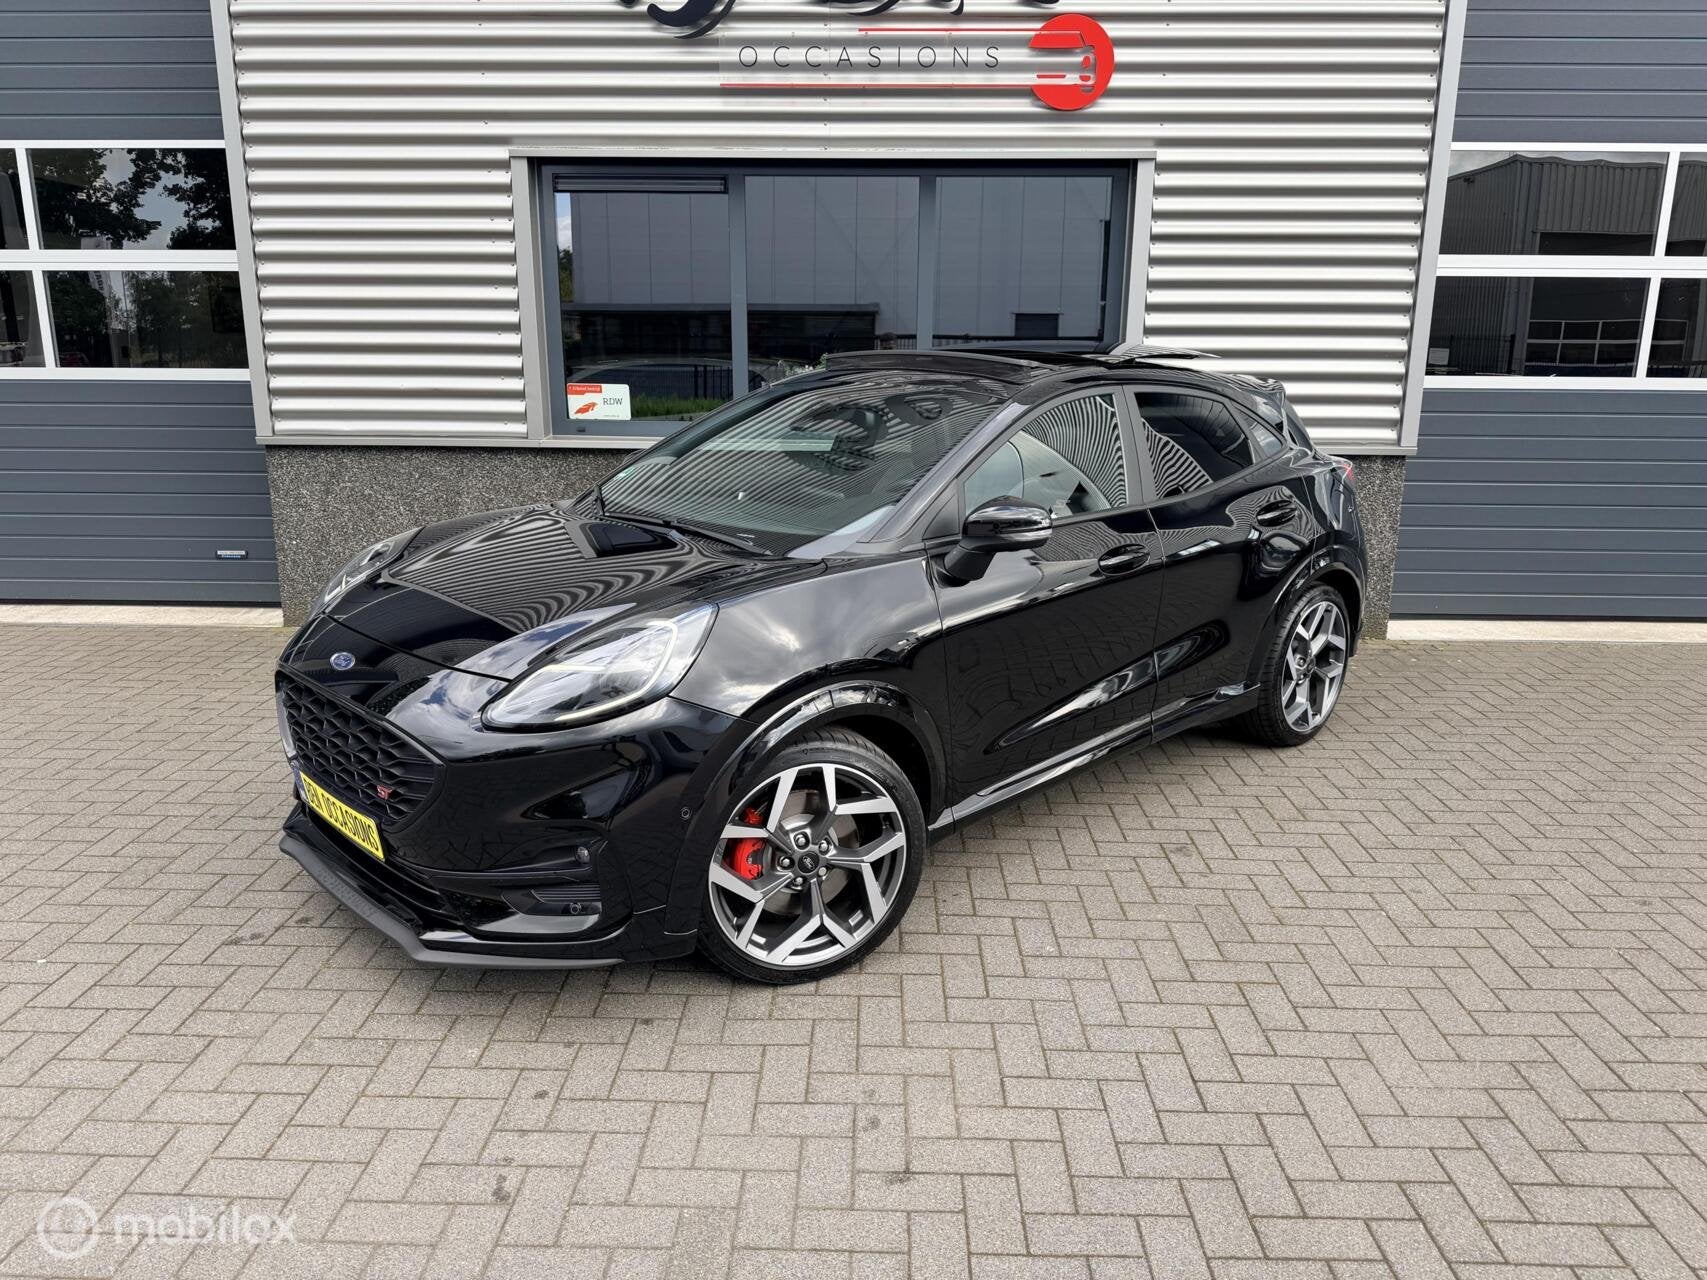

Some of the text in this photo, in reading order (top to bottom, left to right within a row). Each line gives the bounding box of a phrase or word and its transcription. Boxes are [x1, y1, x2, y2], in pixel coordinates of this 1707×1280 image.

[738, 45, 1000, 69] OCCASIONS
[376, 784, 393, 800] ST
[321, 792, 379, 852] OCCASIONS
